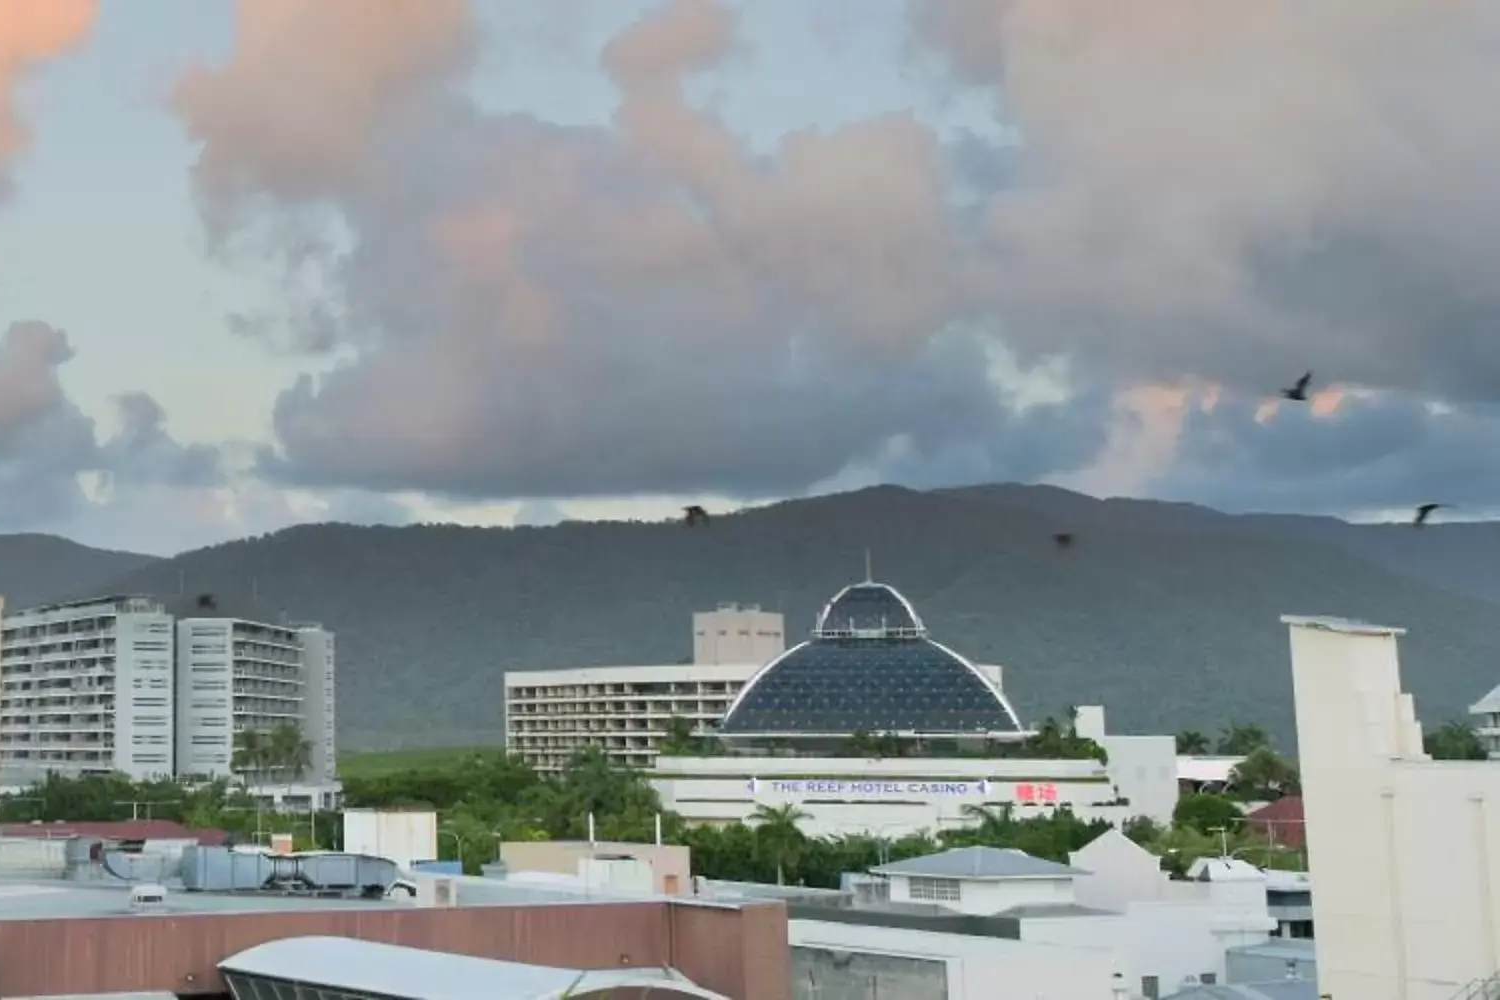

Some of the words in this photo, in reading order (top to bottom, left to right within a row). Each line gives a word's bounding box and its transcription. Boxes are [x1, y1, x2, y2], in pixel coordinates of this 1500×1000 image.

[771, 781, 801, 792] THE
[807, 781, 845, 793] REEF
[850, 782, 904, 793] HOTEL
[907, 783, 968, 794] CASINO
